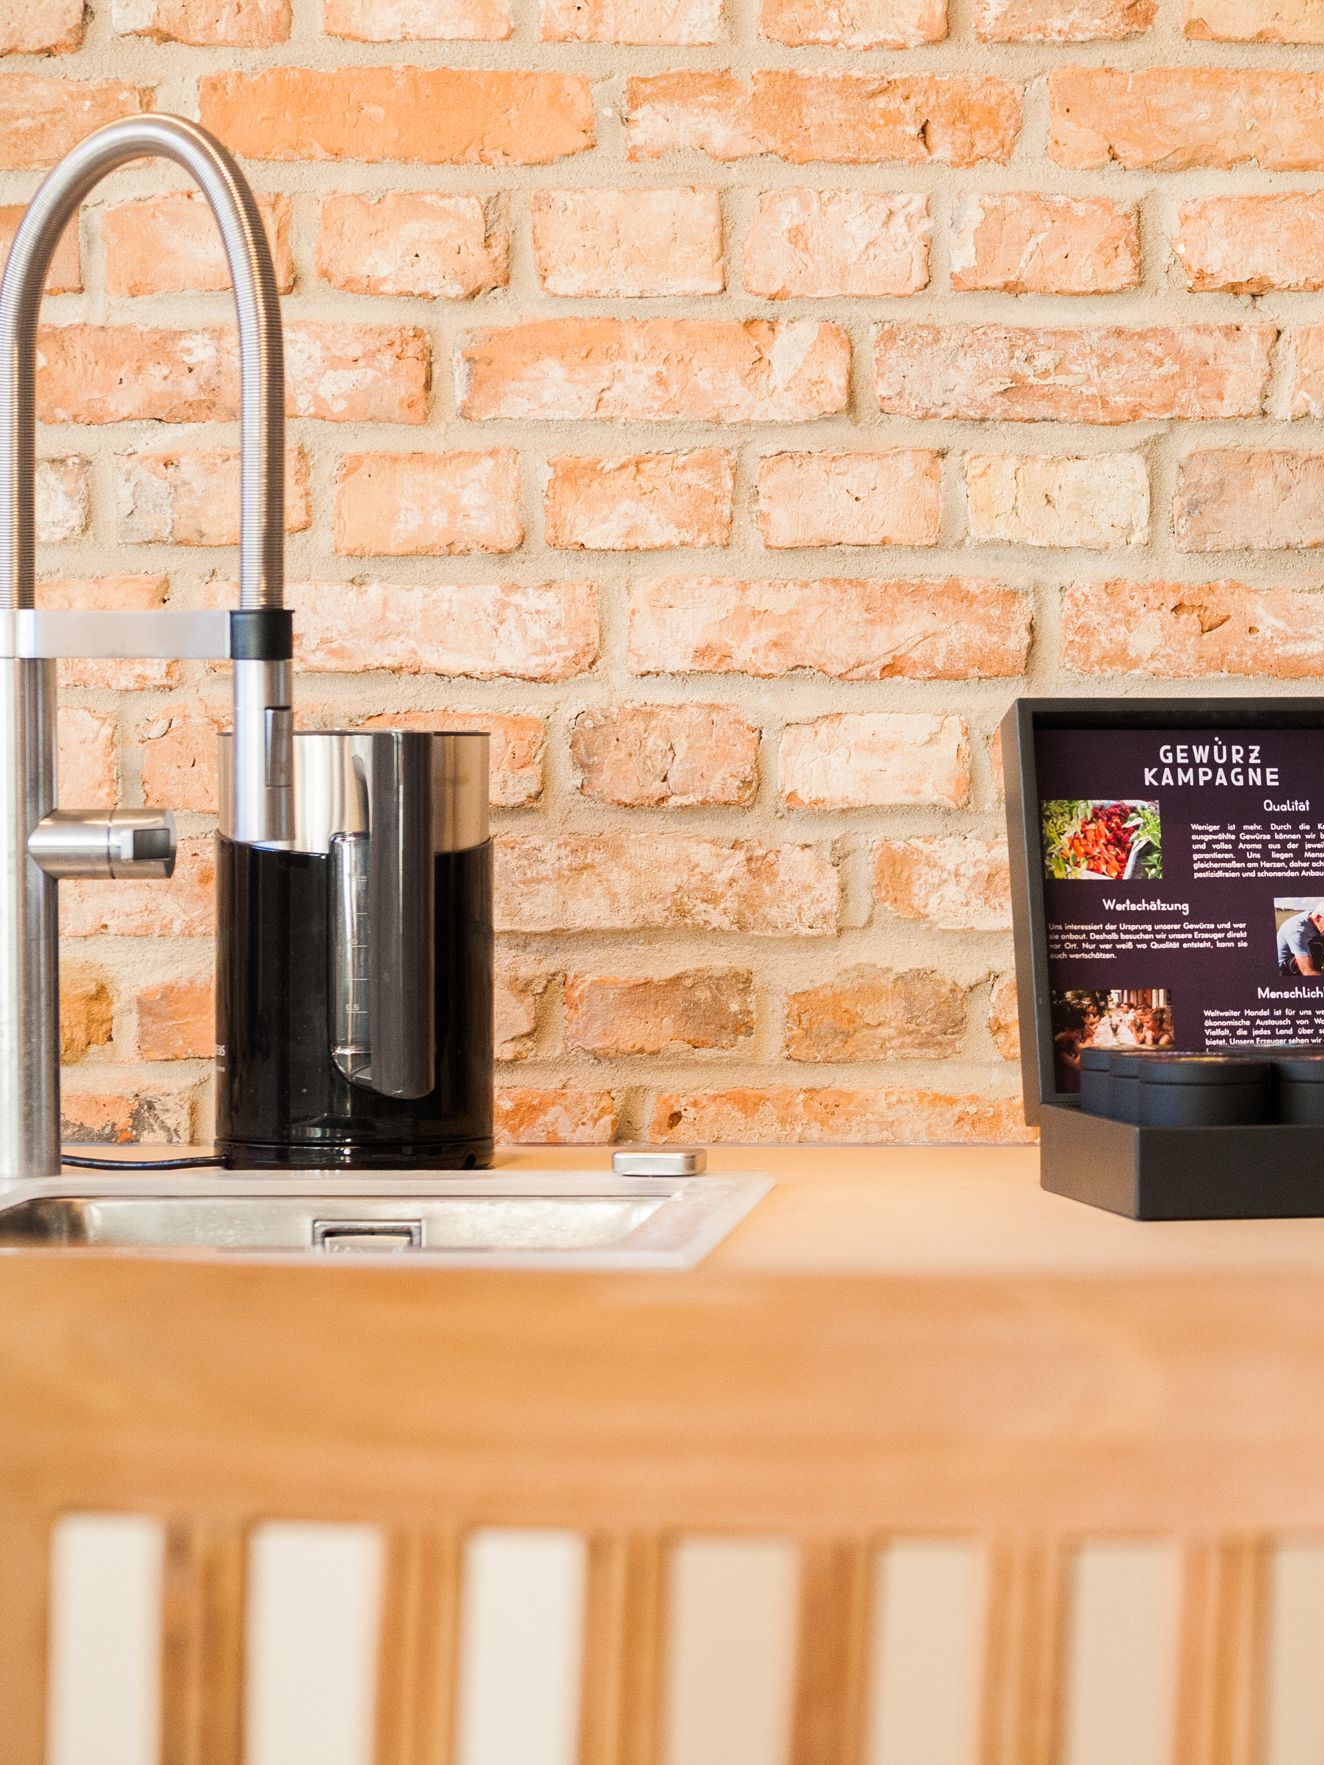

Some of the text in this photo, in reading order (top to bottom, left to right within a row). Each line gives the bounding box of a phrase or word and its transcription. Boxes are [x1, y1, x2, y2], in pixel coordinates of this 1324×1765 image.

[1159, 736, 1261, 764] GEWÜRZ
[1144, 767, 1280, 786] KAMPAGNE
[1263, 799, 1310, 812] Qualität
[1190, 823, 1221, 832] Weniger
[1227, 823, 1236, 831] ist
[1243, 823, 1263, 831] mehr.
[1270, 823, 1292, 831] Durch
[1299, 822, 1310, 830] die
[1191, 832, 1236, 842] ausgewählte
[1239, 832, 1271, 840] Gewürze
[1274, 832, 1301, 840] können
[1304, 832, 1316, 840] wir
[1192, 842, 1206, 850] und
[1286, 841, 1299, 849] der
[1192, 852, 1236, 860] garantieren.
[1246, 851, 1261, 859] Uns
[1271, 851, 1293, 860] liegen
[1193, 861, 1246, 870] gleichermaßen
[1260, 860, 1288, 869] Herzen,
[1289, 860, 1310, 868] daher
[1194, 870, 1240, 880] pestizidfreien
[1242, 870, 1256, 878] und
[1257, 870, 1300, 878] schonenden
[1102, 898, 1190, 916] Wertschätzung
[1048, 923, 1063, 931] Uns
[1064, 923, 1103, 931] interessiert
[1104, 922, 1117, 930] der
[1119, 922, 1153, 931] Ursprung
[1183, 922, 1215, 930] Gewürze
[1216, 921, 1231, 929] und
[1060, 932, 1088, 940] anbaut.
[1089, 932, 1119, 940] Deshalb
[1120, 931, 1154, 940] besuchen
[1194, 931, 1225, 940] Erzeuger
[1115, 941, 1133, 949] weiß
[1150, 941, 1180, 949] Qualität
[1182, 941, 1213, 949] entsteht,
[1216, 940, 1235, 948] kann
[1237, 940, 1248, 948] sie
[1050, 951, 1117, 959] auch wertschätzen.
[1203, 1009, 1241, 1017] Weltweiter
[1244, 1008, 1270, 1016] Handel
[1273, 1008, 1282, 1016] ist
[1285, 1008, 1296, 1016] für
[1204, 1018, 1250, 1027] ökonomische
[1255, 1018, 1291, 1026] Austausch
[1204, 1028, 1232, 1036] Vielfalt,
[1236, 1027, 1248, 1035] die
[1252, 1027, 1271, 1037] jedes
[1275, 1027, 1293, 1035] Land
[1229, 1037, 1255, 1045] Unsere
[1288, 1036, 1310, 1044] sehen
[1311, 1036, 1322, 1044] wir
